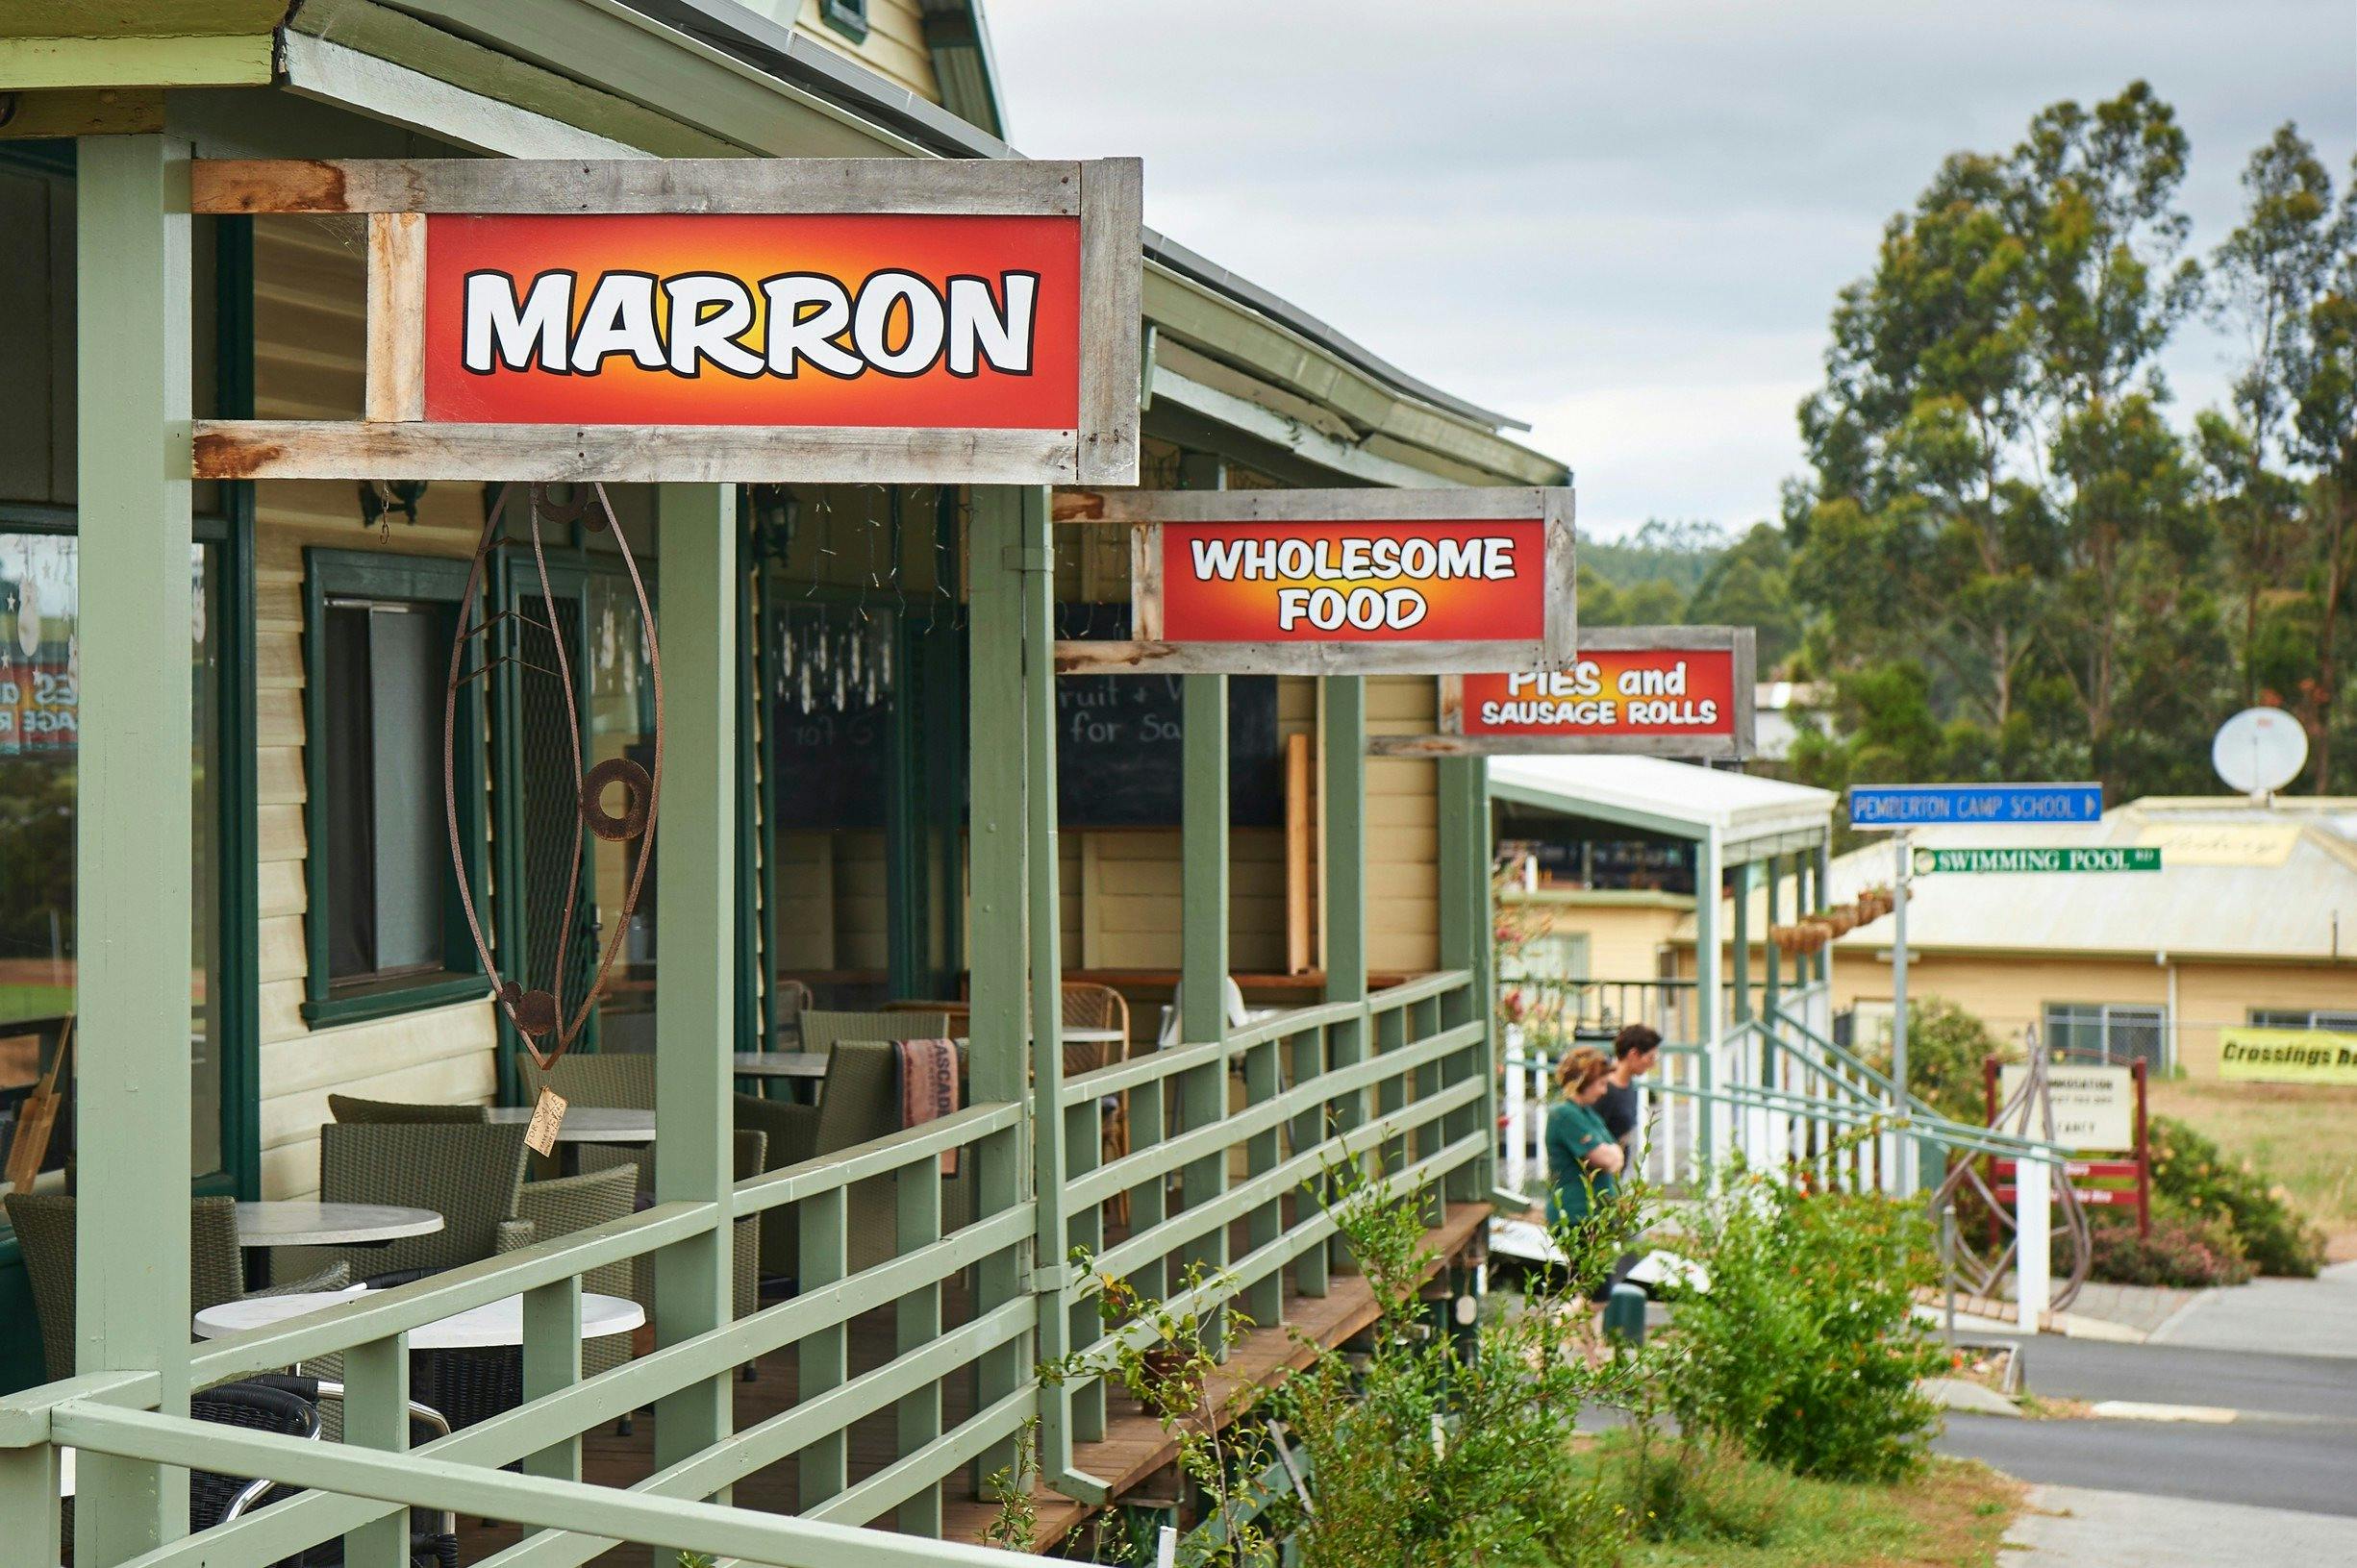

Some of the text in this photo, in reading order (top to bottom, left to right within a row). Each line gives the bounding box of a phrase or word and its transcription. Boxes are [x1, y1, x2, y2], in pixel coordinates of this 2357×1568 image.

[463, 268, 1041, 380] MARRON
[1191, 537, 1516, 581] WHOLESOME
[1278, 587, 1427, 631] FOOD
[1058, 674, 1118, 707] ruit
[1507, 660, 1687, 697] PIES and
[1070, 709, 1122, 743] for
[1481, 698, 1718, 725] SAUSAGE ROLLS
[1854, 794, 2076, 820] PEMBERTON CAMP SCHOOL
[1939, 850, 2061, 871] SWIMMING
[2070, 850, 2130, 870] POOL
[2222, 1040, 2332, 1067] Crossings
[936, 1039, 951, 1118] ASCAD
[527, 1124, 538, 1144] FOR
